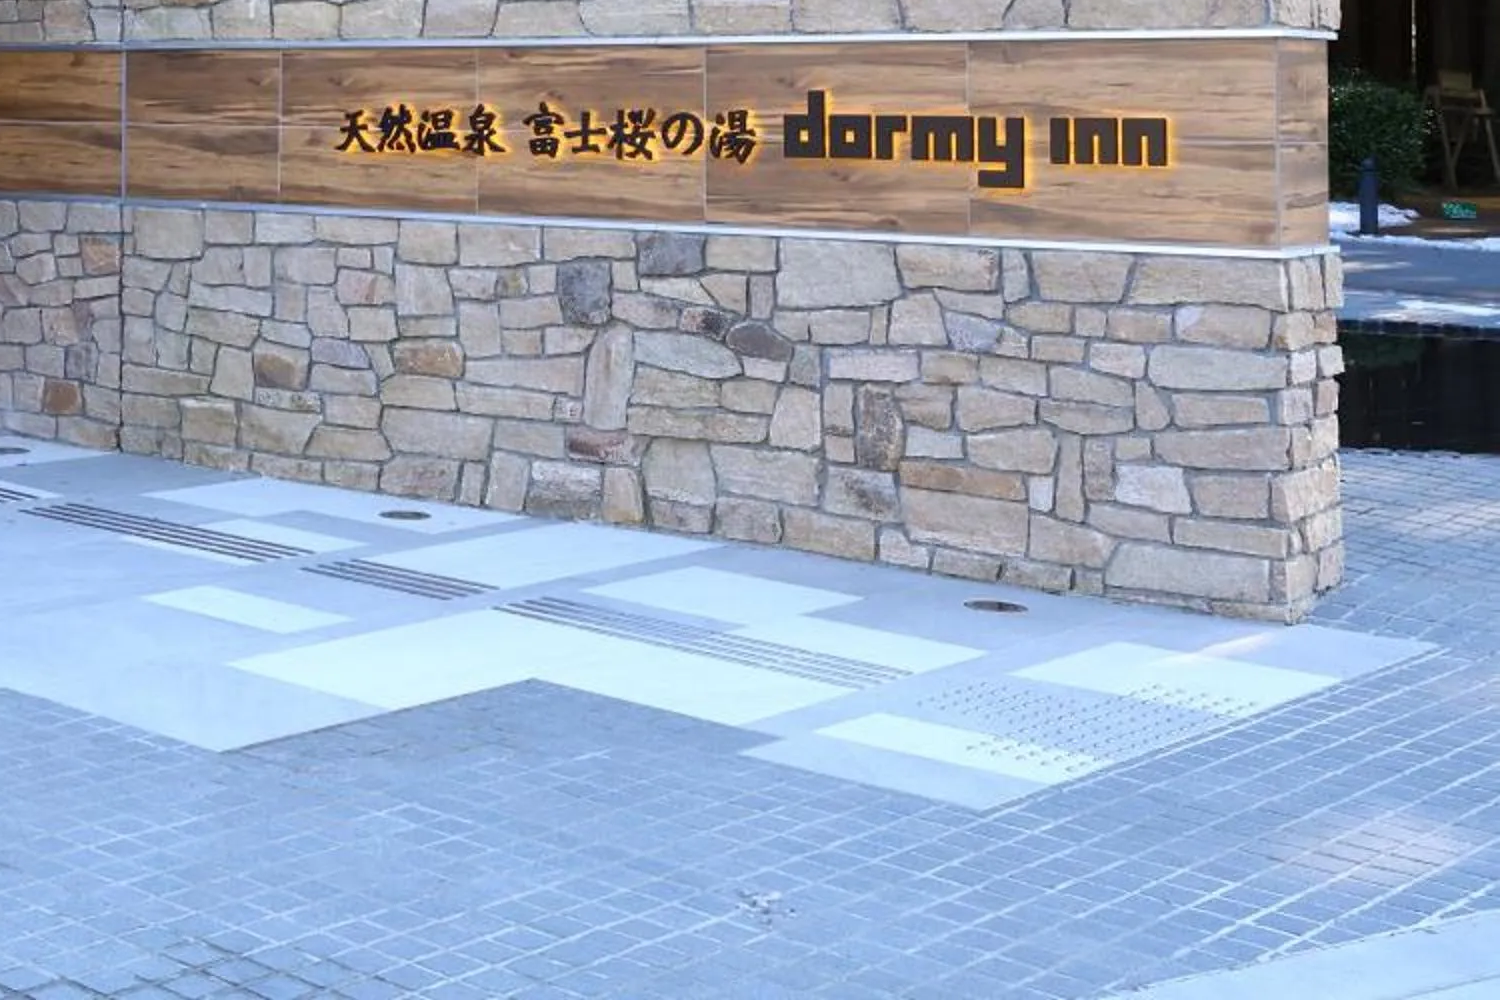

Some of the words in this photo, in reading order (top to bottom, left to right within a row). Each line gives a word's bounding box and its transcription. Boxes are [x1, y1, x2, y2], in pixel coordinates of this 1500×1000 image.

[334, 103, 506, 155] 天然温泉
[522, 101, 758, 164] 富士桜の湯
[783, 89, 1025, 188] dormy
[1050, 117, 1167, 167] inn
